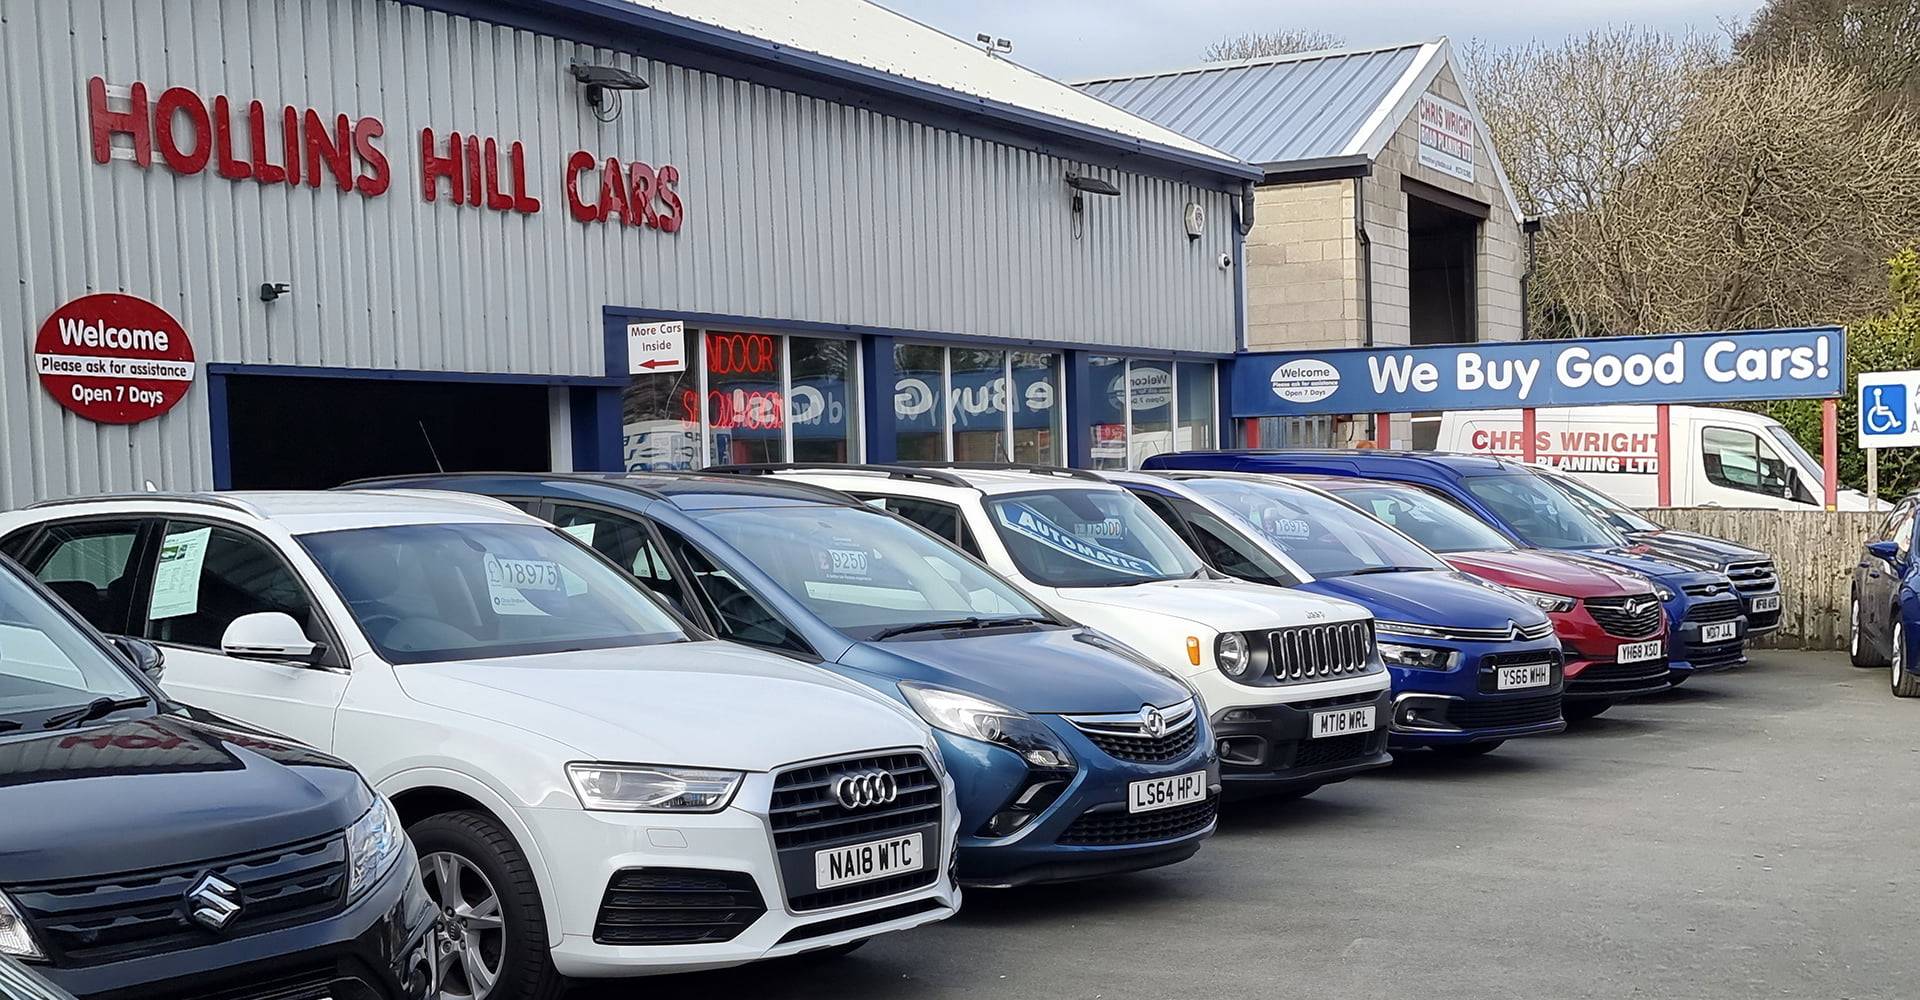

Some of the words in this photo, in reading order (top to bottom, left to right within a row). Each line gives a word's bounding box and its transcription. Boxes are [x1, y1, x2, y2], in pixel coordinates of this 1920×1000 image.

[1420, 99, 1444, 128] CHRIS
[1445, 108, 1472, 140] WRIGHT
[89, 76, 391, 197] HOLLINS
[422, 127, 541, 213] HILL
[566, 150, 684, 233] CARS
[59, 318, 169, 351] Welcome
[631, 326, 657, 336] More
[660, 323, 681, 334] Cars
[642, 341, 672, 351] Inside
[705, 334, 773, 374] NDOOR
[41, 357, 82, 372] Please
[86, 360, 106, 373] ask
[110, 360, 126, 374] for
[130, 362, 187, 377] assistance
[1281, 368, 1330, 378] Welcome
[1368, 355, 1439, 394] We
[1456, 352, 1541, 400] Buy
[1556, 340, 1685, 388] Good
[1703, 336, 1829, 383] Cars!
[71, 384, 112, 405] Open
[115, 386, 125, 402] 7
[129, 386, 164, 408] Days
[1310, 389, 1325, 397] Days
[1472, 430, 1550, 451] CHRS
[1018, 511, 1143, 571] AUTOMATIC
[832, 552, 866, 570] 9250
[505, 563, 556, 585] 18975
[1622, 646, 1642, 660] YH68
[1503, 669, 1527, 686] YS66
[1530, 667, 1547, 684] WHH
[1321, 714, 1345, 733] MT18
[1349, 711, 1368, 729] WRL
[1137, 780, 1173, 807] LS64
[1178, 775, 1200, 800] HPJ
[830, 847, 873, 880] NA18
[878, 839, 912, 871] WTC
